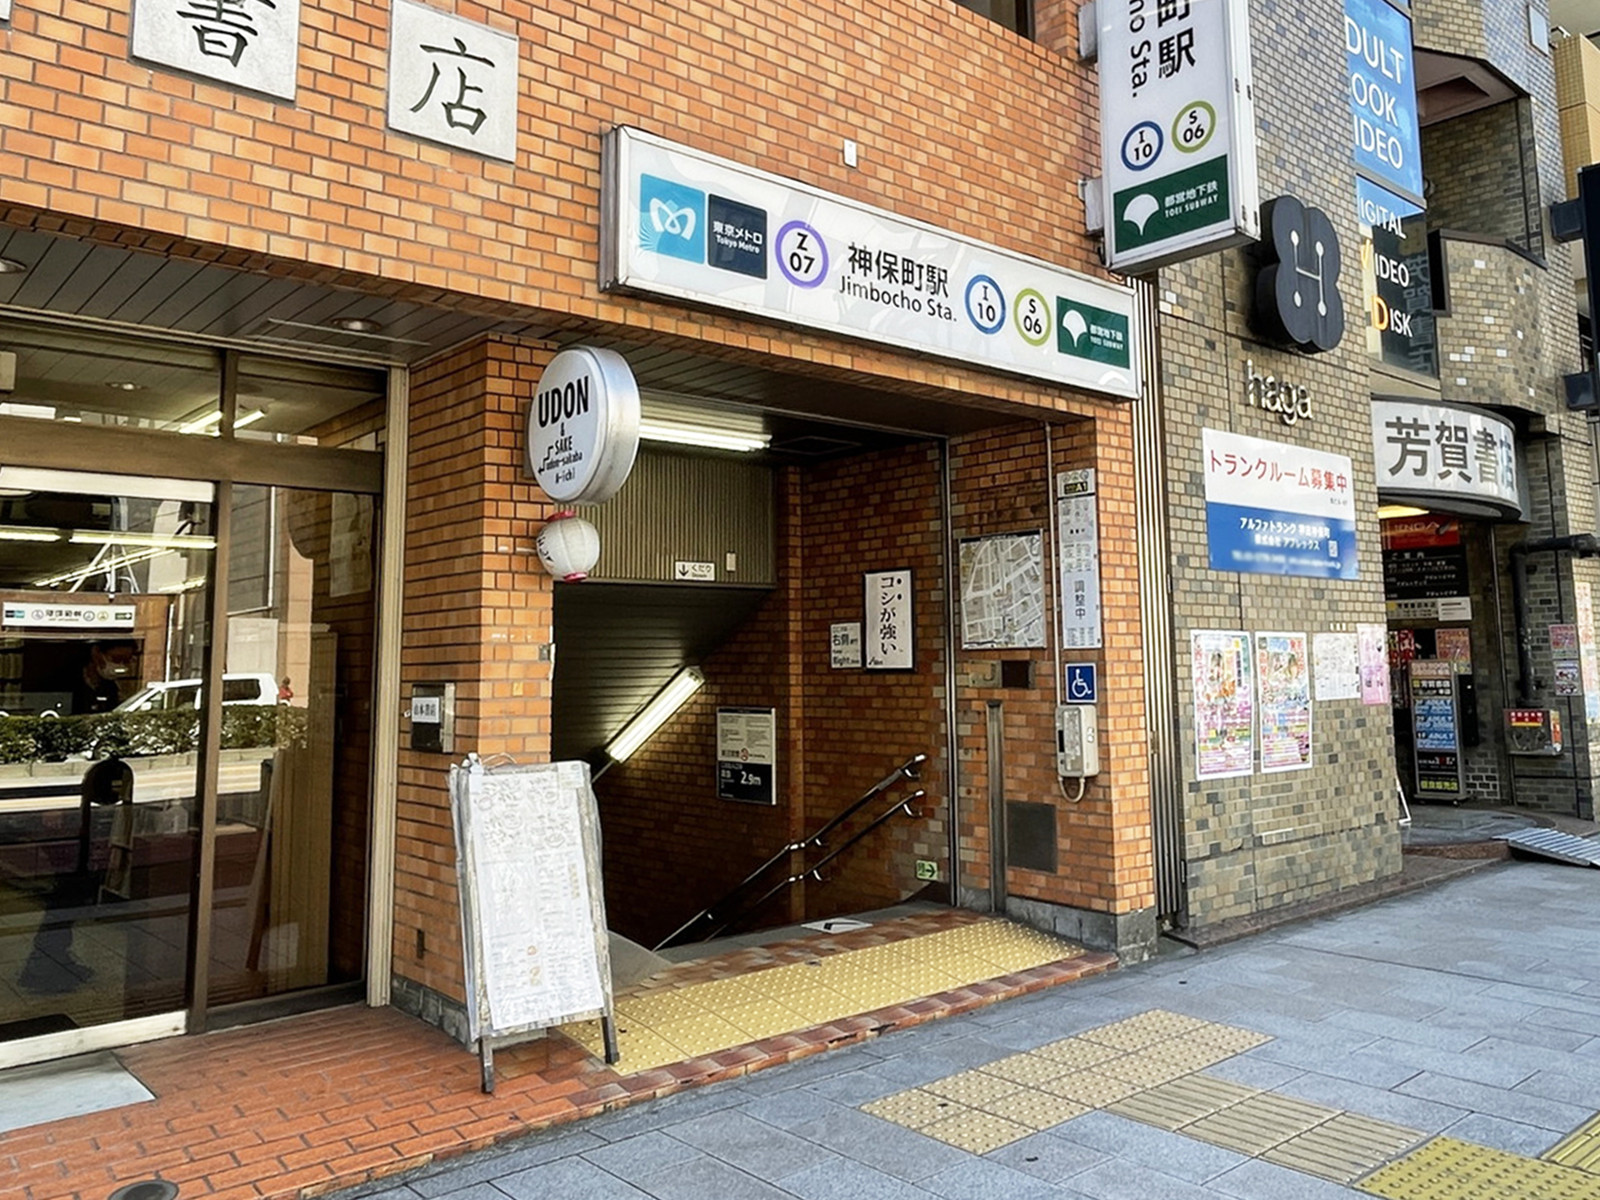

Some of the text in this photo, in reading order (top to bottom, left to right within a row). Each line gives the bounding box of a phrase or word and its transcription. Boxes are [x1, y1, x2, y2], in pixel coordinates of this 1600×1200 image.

[1130, 39, 1151, 98] Sta.
[1188, 109, 1198, 125] S
[1138, 129, 1145, 144] I
[1183, 124, 1205, 144] 06
[1134, 142, 1153, 161] 10
[1164, 193, 1219, 219] TOEI SUBWAY
[712, 220, 763, 246] 東京メトロ
[715, 233, 761, 255] Tokyo Metro
[796, 231, 809, 252] Z
[789, 251, 816, 275] 07
[847, 240, 950, 300] 神保町駅
[839, 274, 958, 322] Jimbocho Sta.
[982, 285, 989, 301] I
[976, 302, 996, 323] 10
[1028, 298, 1037, 315] S
[1370, 294, 1414, 338] DISK
[1023, 314, 1043, 335] 06
[538, 375, 589, 428] UDON
[1244, 359, 1314, 426] haga
[1384, 415, 1515, 492] 芳賀書店
[1210, 449, 1348, 494] トランクルーム募集中
[880, 576, 898, 656] コシが強い
